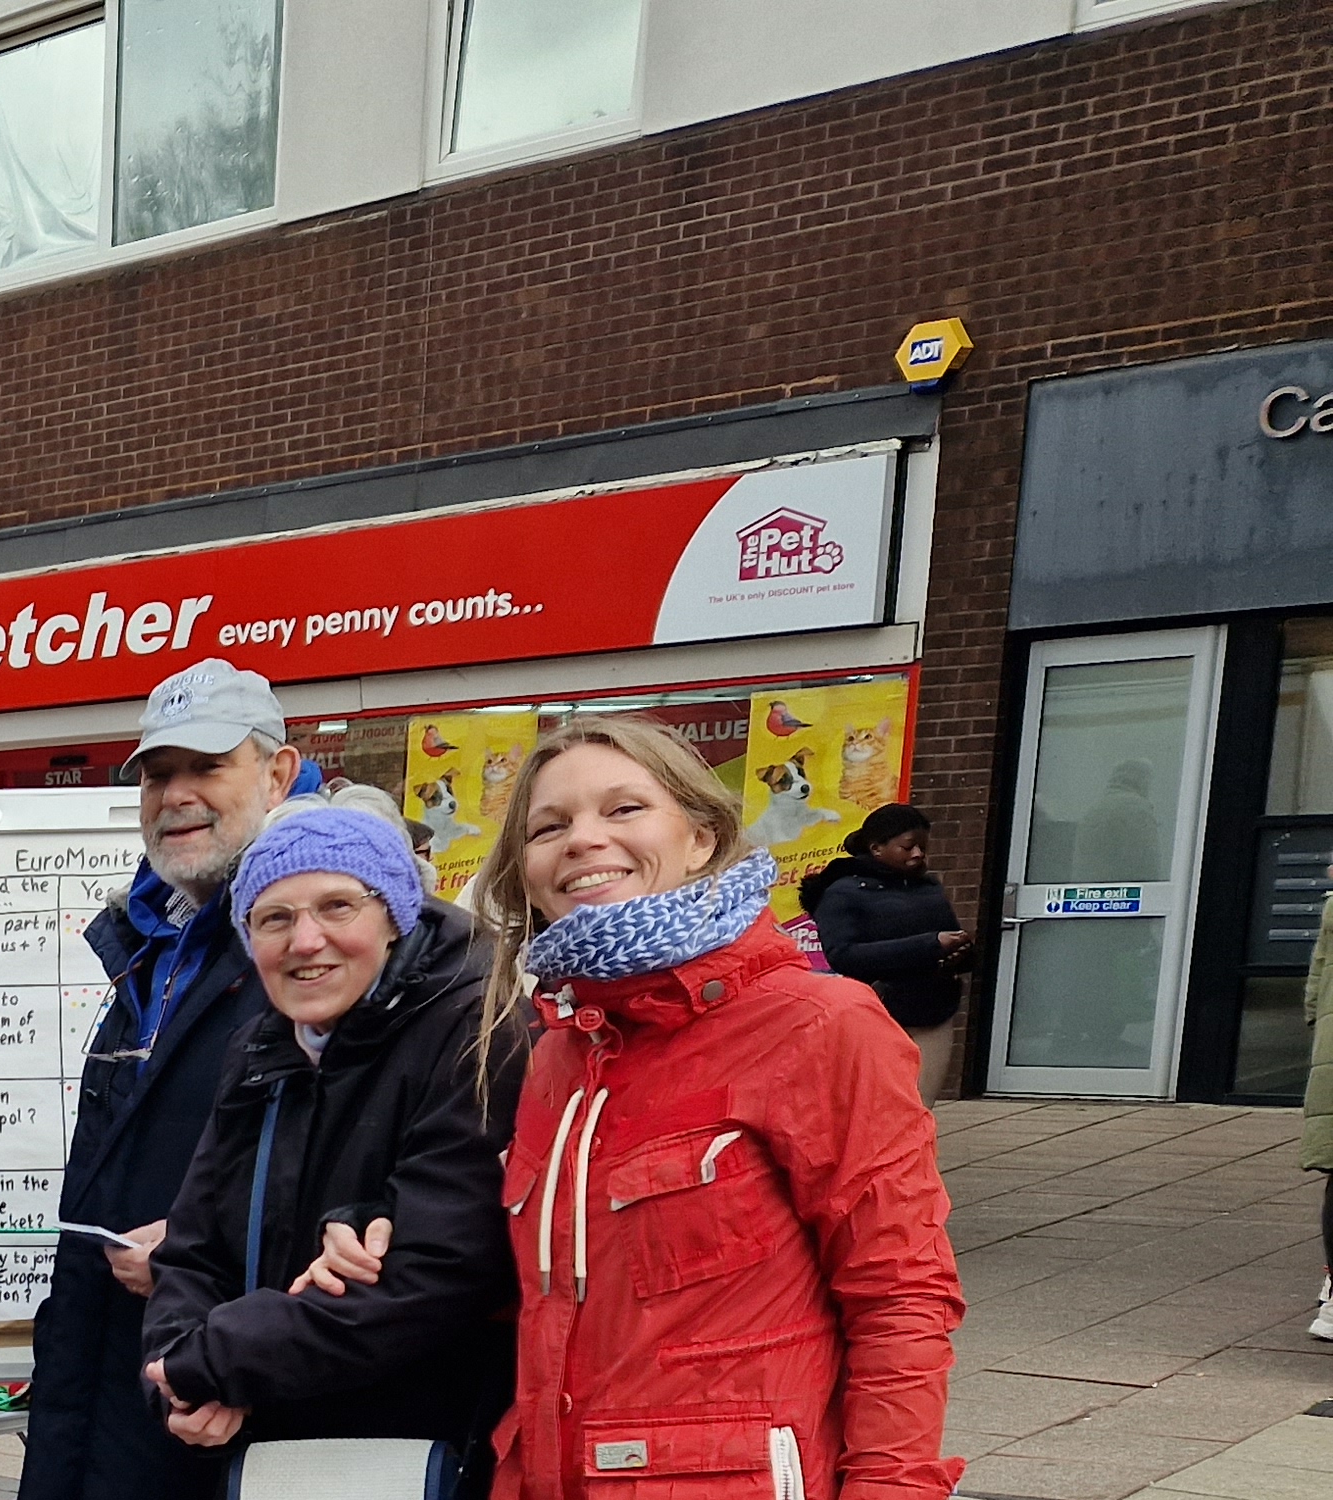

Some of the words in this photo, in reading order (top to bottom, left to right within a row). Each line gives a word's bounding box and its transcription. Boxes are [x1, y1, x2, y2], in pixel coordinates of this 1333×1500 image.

[910, 338, 942, 362] ADT
[1259, 385, 1333, 439] Ca
[760, 525, 814, 552] Pet
[757, 548, 812, 577] Hut
[748, 592, 765, 600] only
[768, 586, 814, 597] DISCOUNT
[817, 586, 830, 594] pet
[833, 583, 855, 591] store
[218, 618, 297, 647] every
[305, 605, 399, 645] penny
[44, 771, 82, 786] STAR
[800, 846, 834, 861] prices
[448, 858, 475, 870] prices
[21, 877, 49, 893] the
[1076, 888, 1100, 899] Fire
[1104, 887, 1128, 898] exit
[1070, 901, 1100, 912] Keep
[1103, 900, 1132, 910] clear
[4, 915, 39, 935] part
[45, 916, 56, 931] in
[797, 928, 819, 941] Pe
[1, 991, 19, 1006] to
[19, 1010, 34, 1026] of
[22, 1174, 49, 1191] the
[14, 1251, 28, 1264] to
